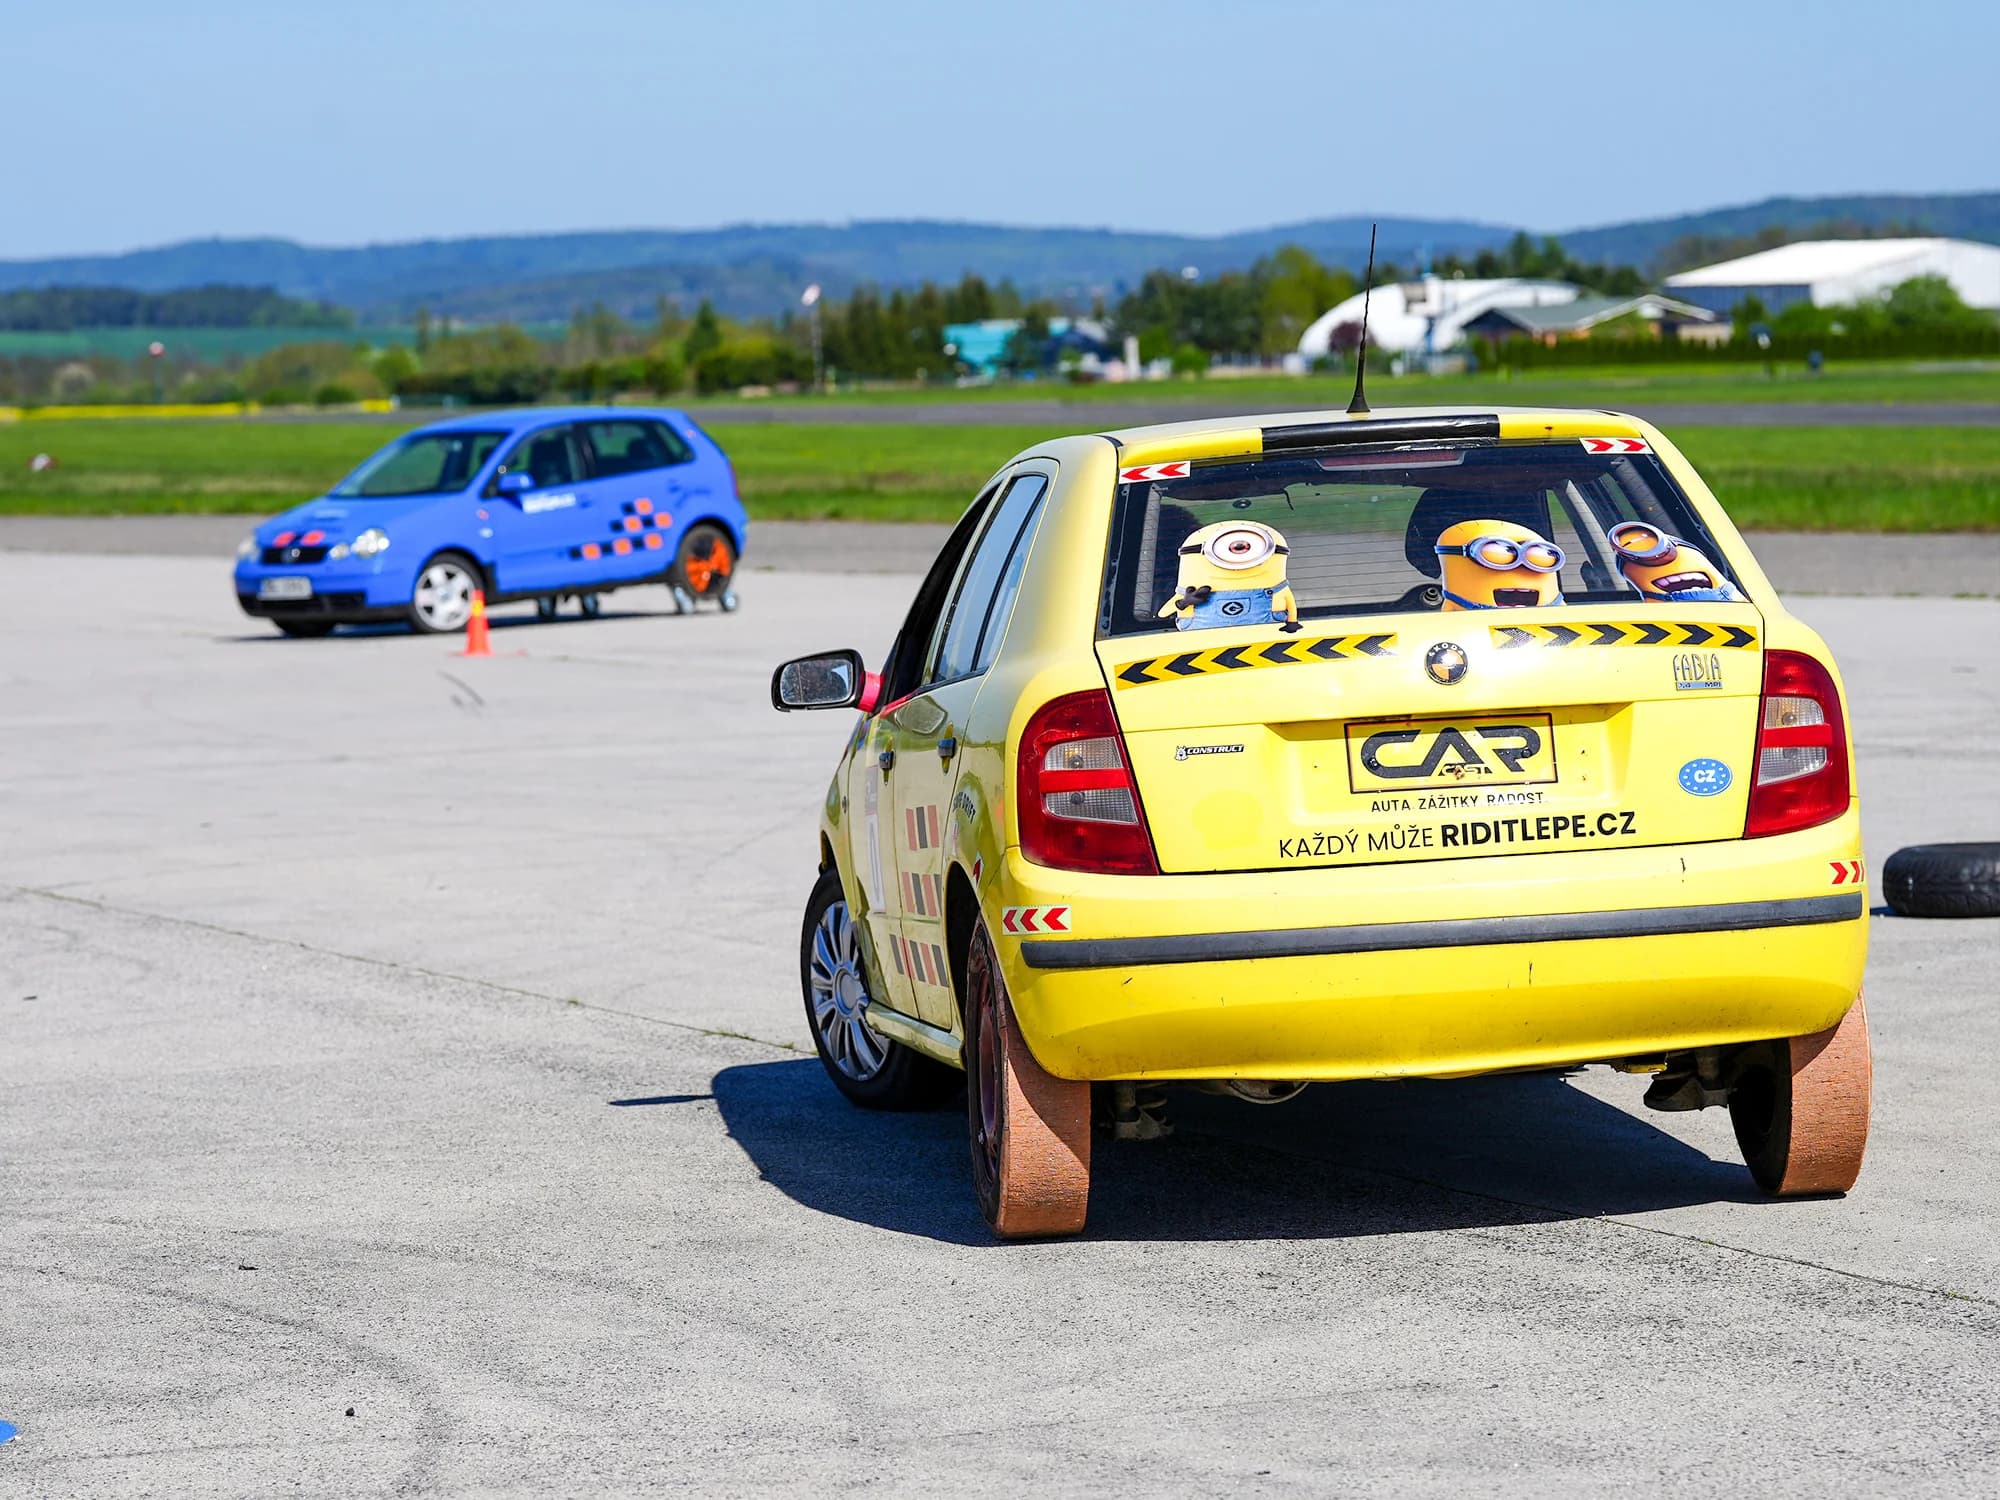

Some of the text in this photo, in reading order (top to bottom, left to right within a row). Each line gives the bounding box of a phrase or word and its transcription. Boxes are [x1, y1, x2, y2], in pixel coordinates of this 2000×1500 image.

[1673, 653, 1722, 681] FABIA
[1187, 745, 1244, 755] CONSTRUCT
[1361, 725, 1541, 779] CAR
[1694, 769, 1717, 783] CZ
[1279, 811, 1637, 858] KAŽDÝ MŮŽE RIDITLEPE.CZ
